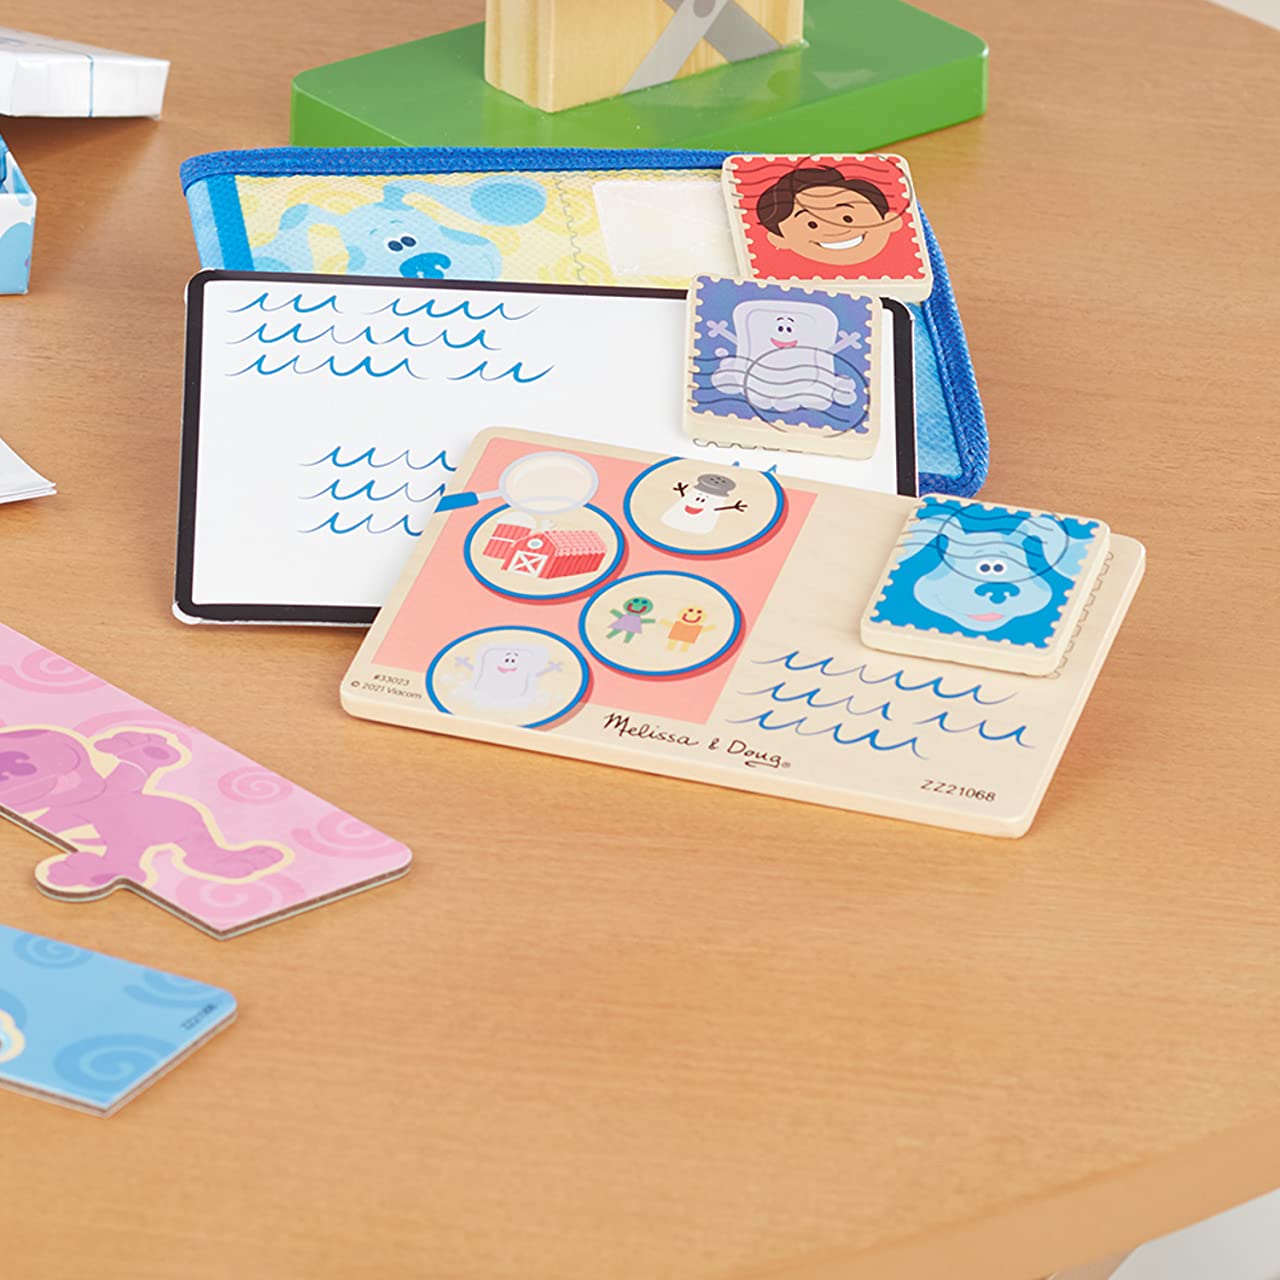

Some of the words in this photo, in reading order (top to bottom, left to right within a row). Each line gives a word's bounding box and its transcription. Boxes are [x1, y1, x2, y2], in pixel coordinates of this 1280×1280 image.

[603, 712, 699, 747] Melissa
[708, 738, 720, 750] &
[920, 779, 996, 802] ZZ21068
